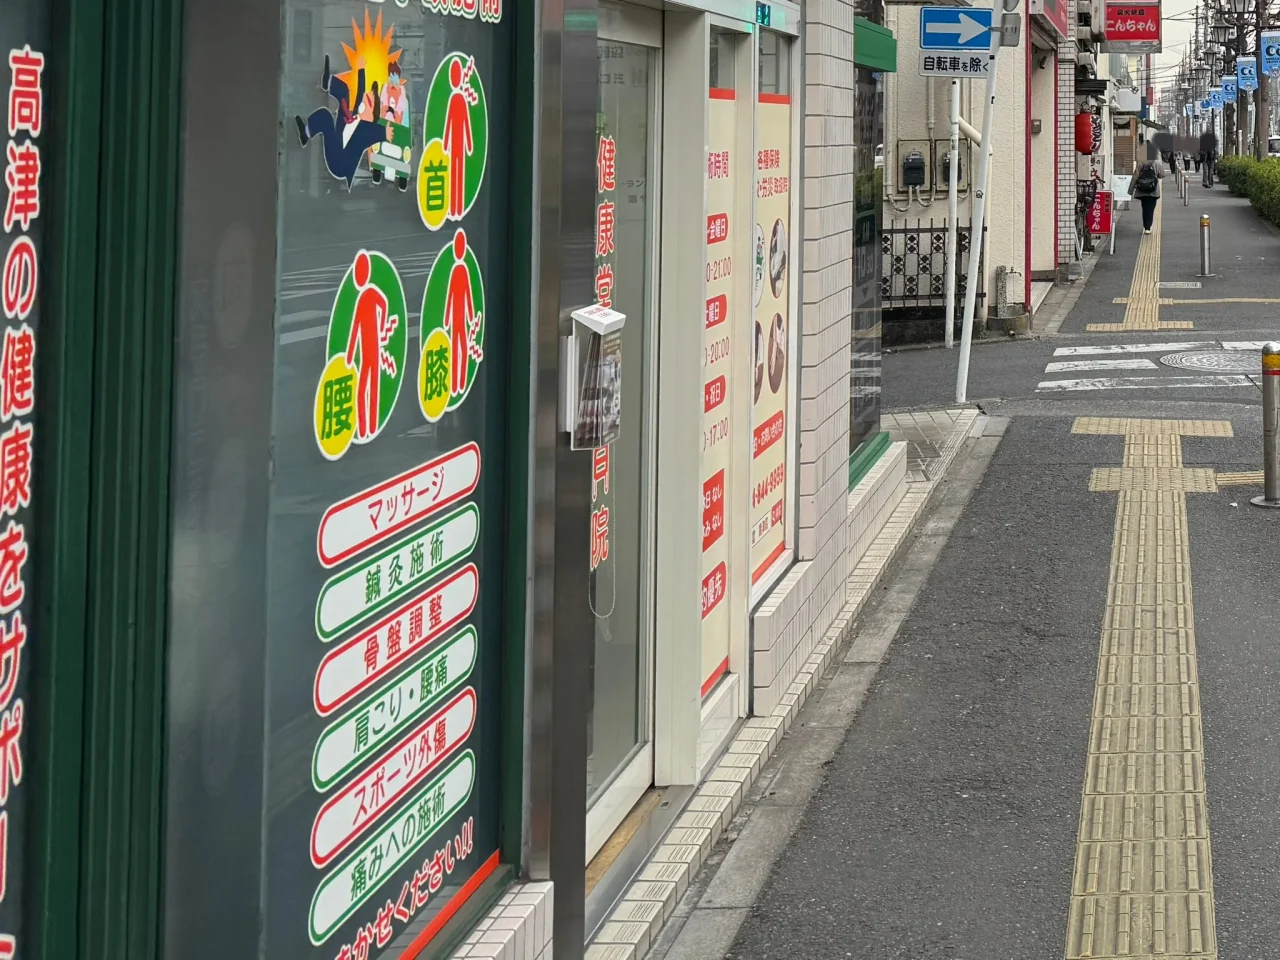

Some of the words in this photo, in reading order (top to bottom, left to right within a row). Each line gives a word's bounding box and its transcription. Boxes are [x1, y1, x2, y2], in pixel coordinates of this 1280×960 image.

[923, 55, 989, 73] 自転車を除く
[424, 159, 452, 212] 首
[321, 377, 355, 441] 腰
[425, 346, 451, 401] 膝
[366, 463, 446, 533] マッサージ
[364, 528, 446, 607] 鍼灸施術
[363, 592, 444, 675] 骨盤調整
[352, 652, 449, 753] 肩こり・腰痛
[352, 720, 447, 827] スポーツ外傷
[351, 781, 446, 901] 痛みへの施術
